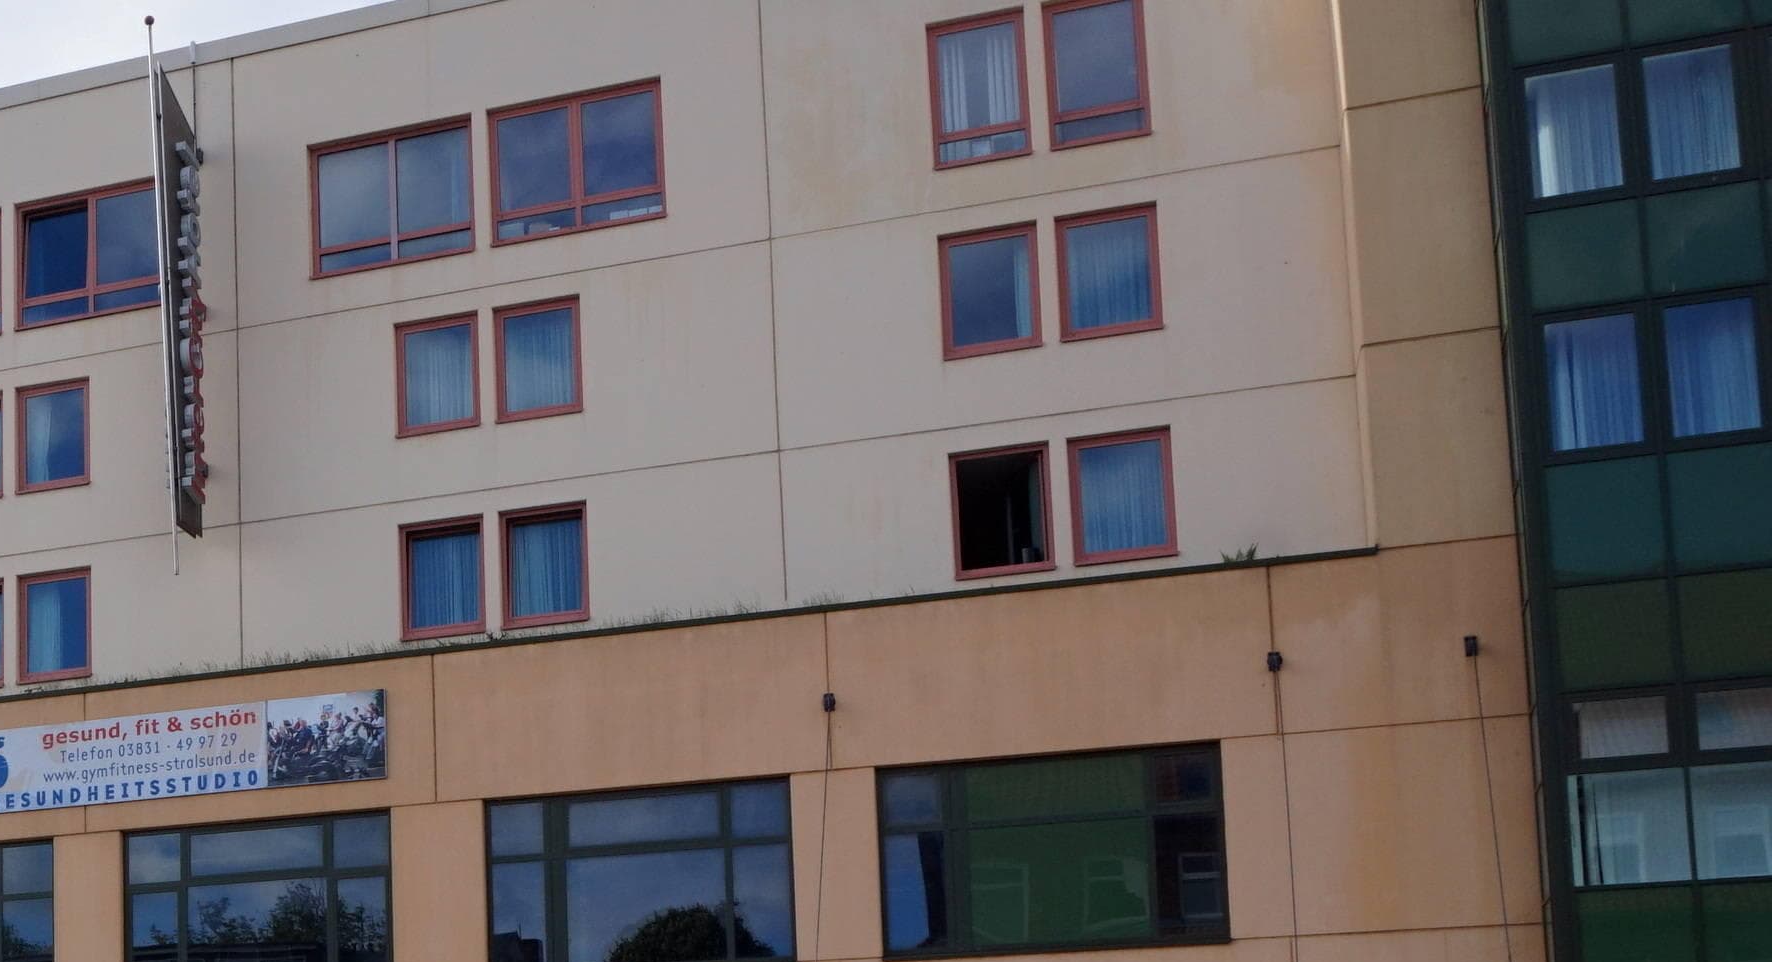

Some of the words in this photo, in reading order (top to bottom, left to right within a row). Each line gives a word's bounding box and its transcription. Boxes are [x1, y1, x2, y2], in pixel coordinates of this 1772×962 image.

[42, 722, 128, 749] gesund,
[135, 719, 160, 736] fit
[167, 716, 183, 733] &
[190, 709, 257, 730] schön
[60, 748, 113, 764] Telefon
[118, 741, 160, 757] 03831
[176, 737, 193, 751] 49
[198, 735, 215, 749] 97
[220, 733, 237, 747] 29
[43, 749, 256, 784] www.gymfitness-stralsund.de
